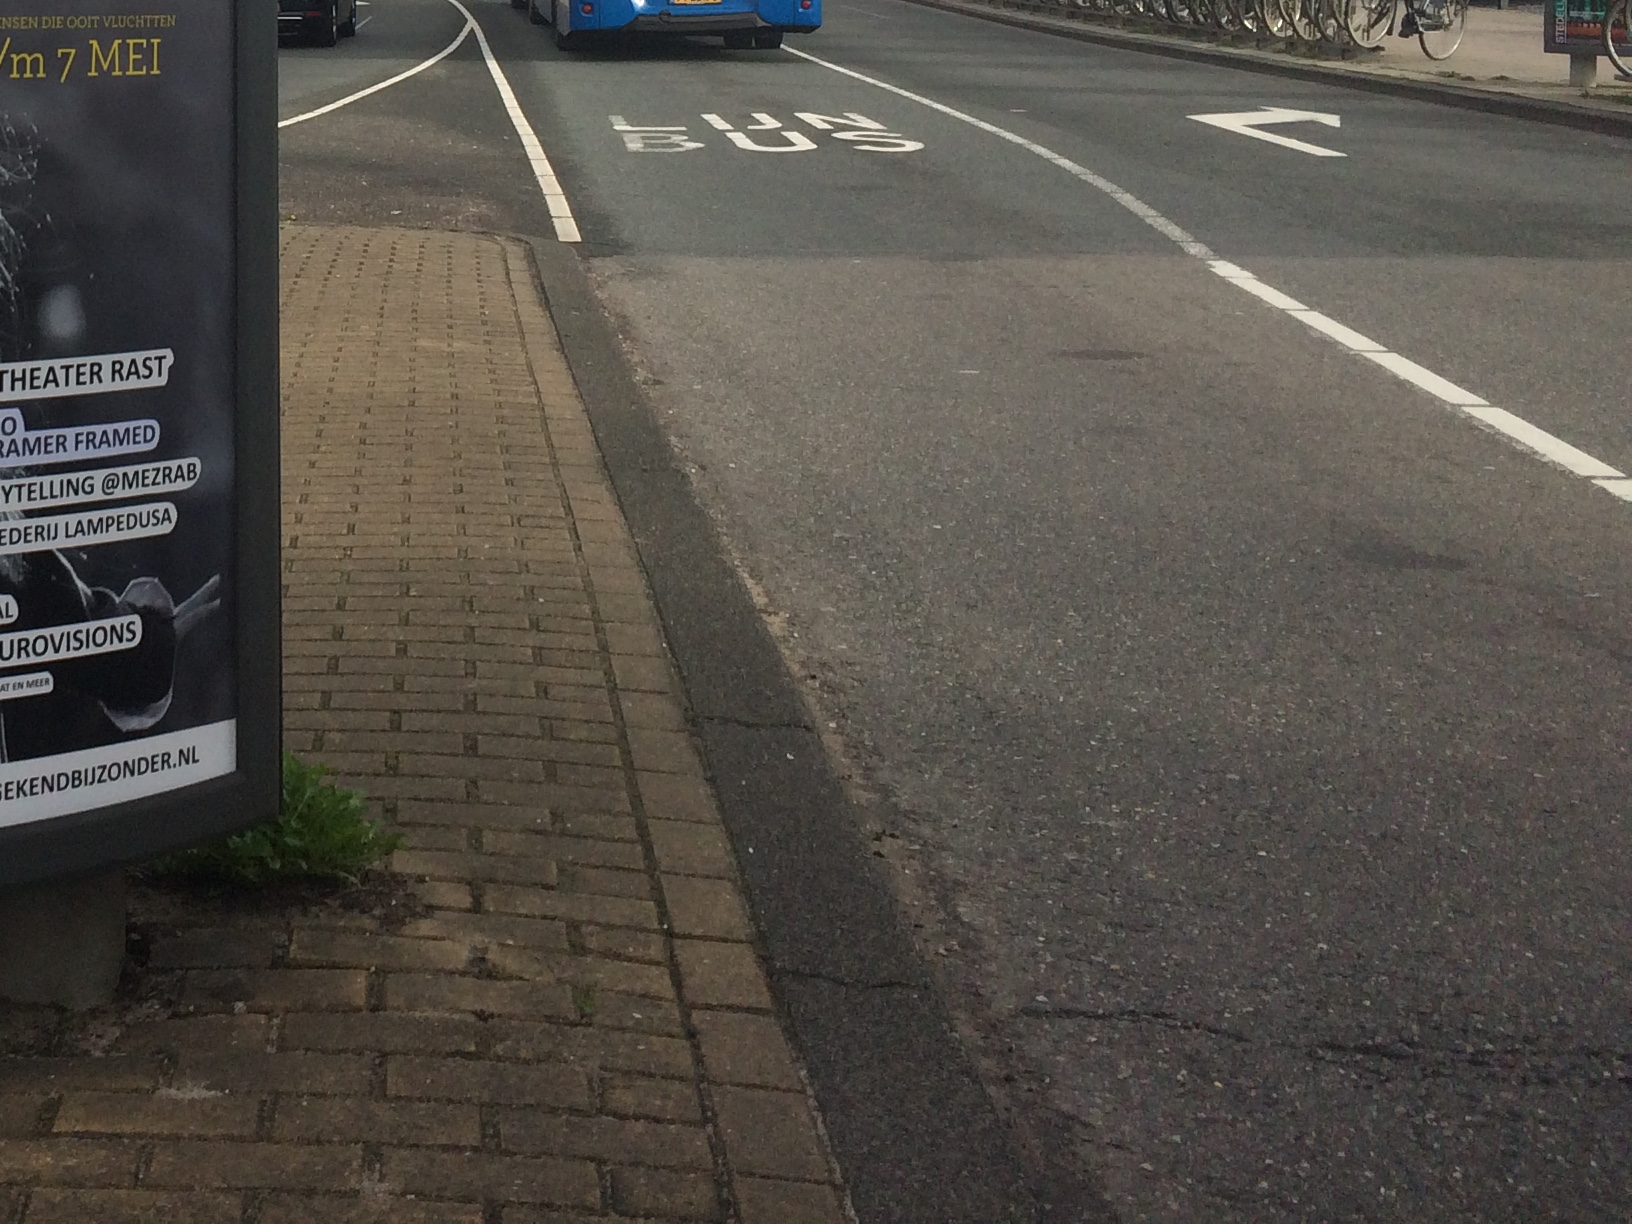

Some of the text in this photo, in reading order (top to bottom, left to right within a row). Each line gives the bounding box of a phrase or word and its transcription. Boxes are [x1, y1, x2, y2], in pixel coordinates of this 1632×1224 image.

[41, 16, 65, 30] DIE
[66, 16, 100, 29] OOIT
[102, 14, 177, 28] VLUCHTTEN
[57, 49, 77, 83] 7
[87, 38, 162, 77] MEI
[621, 131, 925, 153] BUS
[109, 354, 169, 386] RAST
[73, 424, 157, 453] FRAMED
[100, 461, 199, 497] @MEZRAB
[64, 507, 173, 540] LAMPEDUSA
[12, 680, 25, 691] EN
[25, 677, 50, 689] MEER
